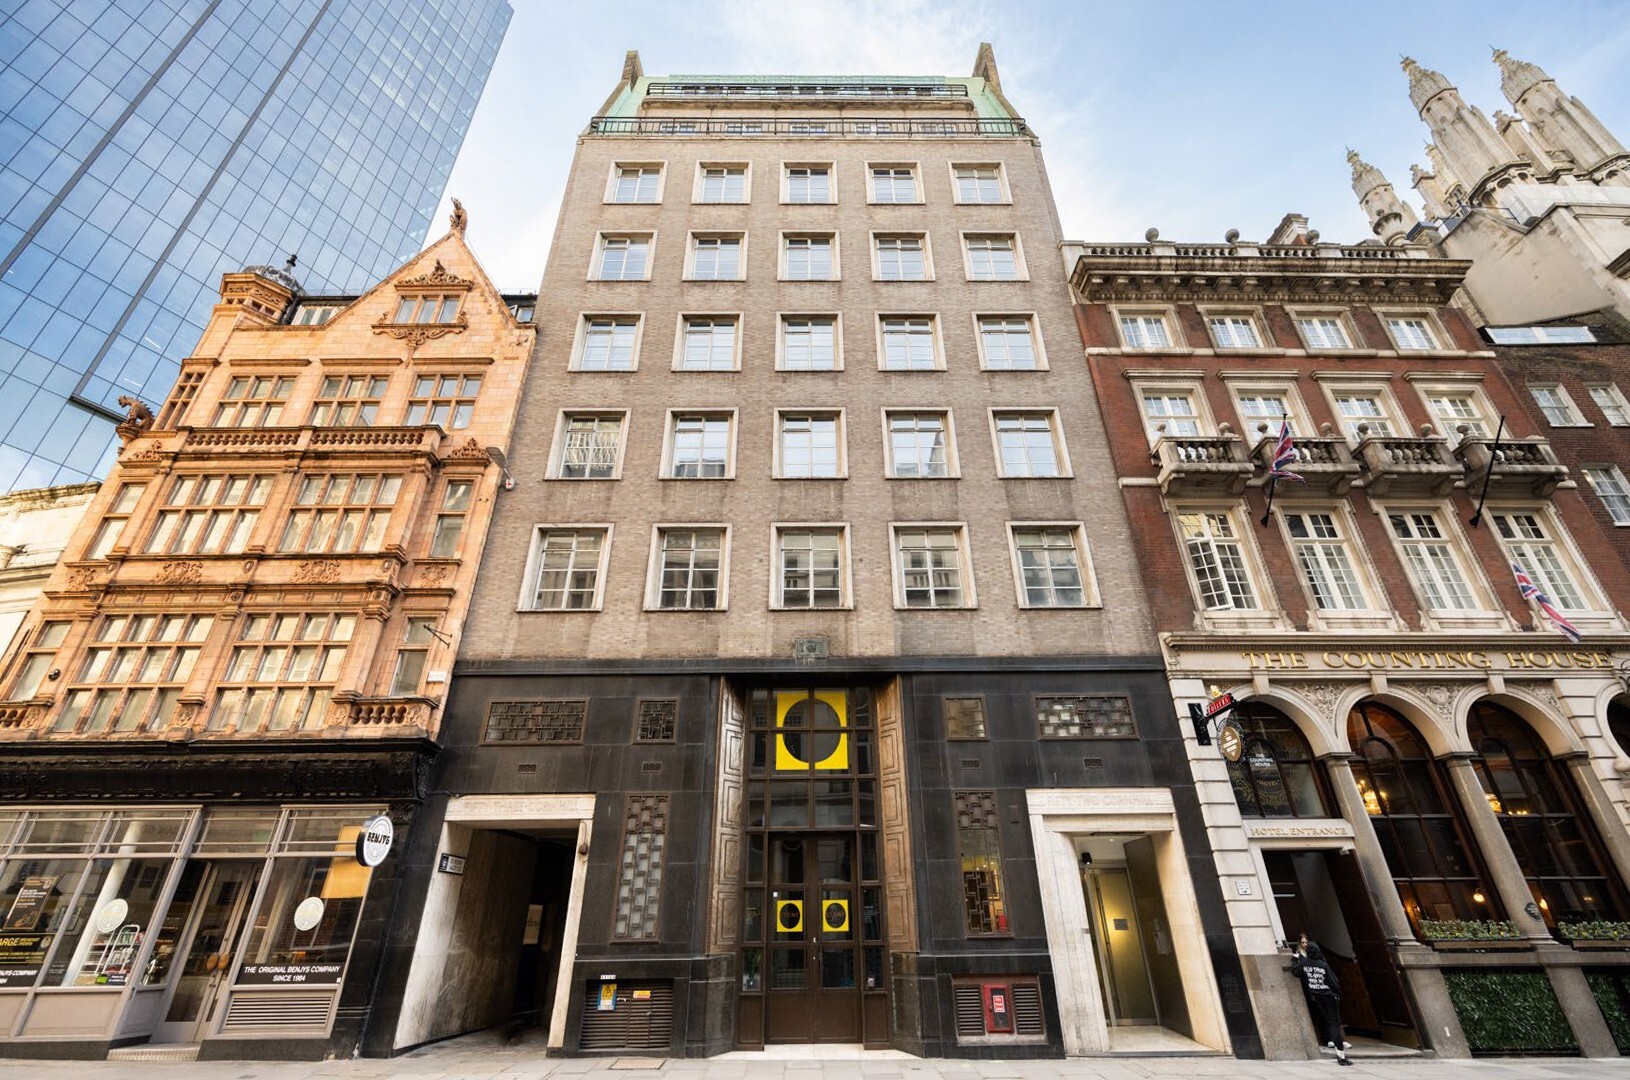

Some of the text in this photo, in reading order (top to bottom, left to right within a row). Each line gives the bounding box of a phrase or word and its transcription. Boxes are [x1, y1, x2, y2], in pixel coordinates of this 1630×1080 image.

[1242, 652, 1614, 669] THE COUNTING HOUSE
[1250, 827, 1348, 836] HOTEL ENTRANCE
[367, 831, 391, 845] BENJYS
[0, 937, 19, 947] ARGE
[244, 966, 257, 974] THE
[258, 966, 287, 974] ORIGINAL
[310, 965, 341, 973] COMPANY
[273, 974, 292, 982] SINCE
